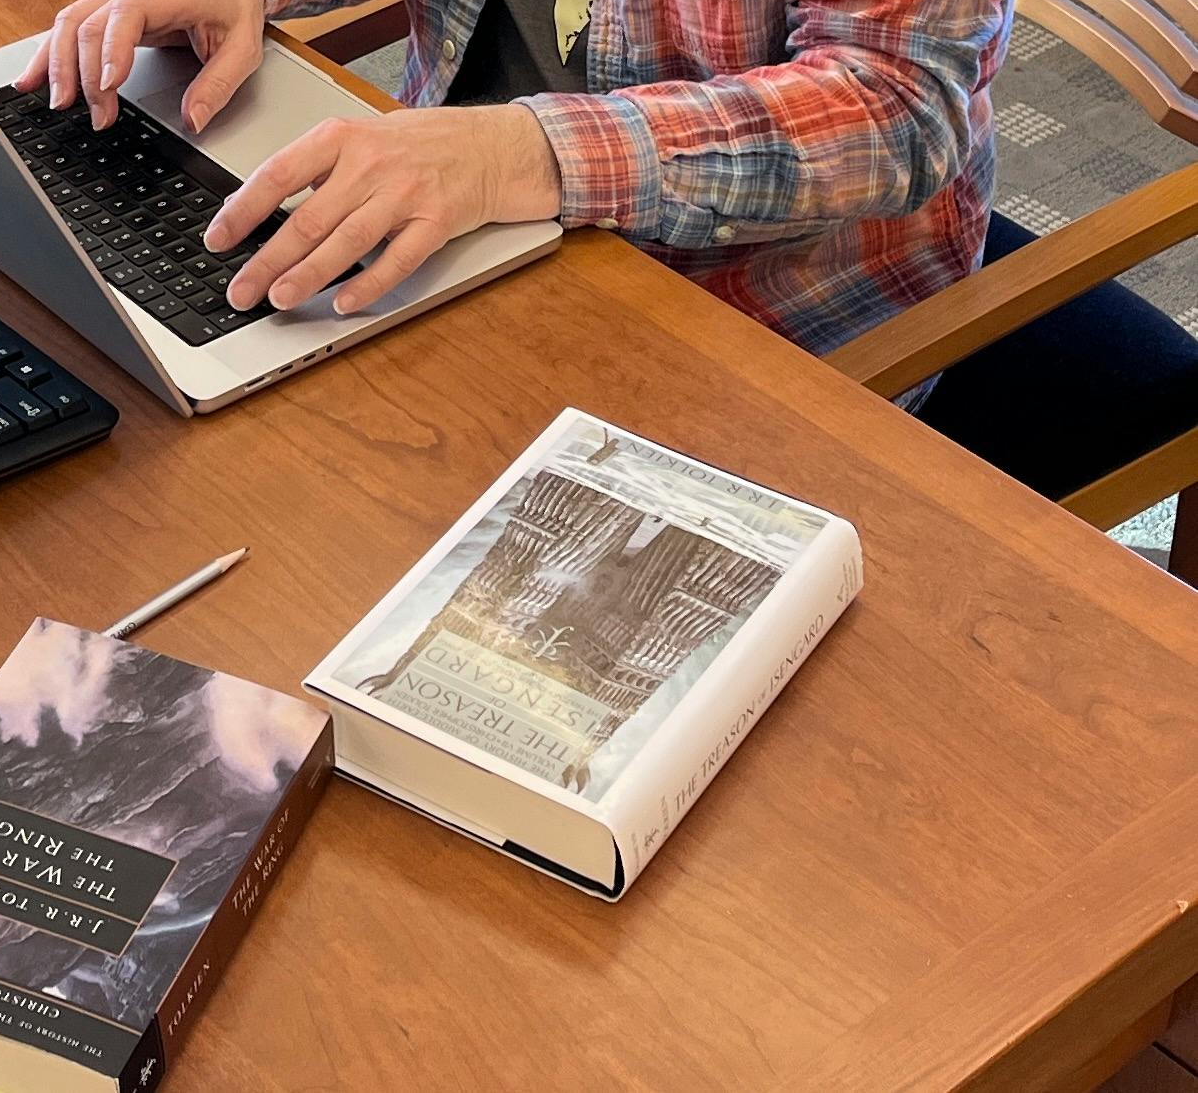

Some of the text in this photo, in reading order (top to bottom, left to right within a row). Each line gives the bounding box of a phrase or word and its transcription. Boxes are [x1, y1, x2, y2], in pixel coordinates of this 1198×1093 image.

[626, 442, 716, 484] TOLKIEN
[397, 672, 514, 737] TREASON
[424, 646, 596, 734] ISENGARD
[488, 697, 507, 708] OF
[673, 781, 699, 811] THE
[701, 705, 755, 780] TREASON
[769, 614, 825, 691] ISENGARD
[520, 728, 569, 763] THE
[2, 850, 63, 886] WAR
[70, 847, 114, 872] THE
[232, 808, 289, 910] THE WAR OF
[72, 875, 116, 903] THE
[243, 840, 284, 917] THE RING
[40, 903, 104, 934] J.R.R.
[168, 958, 210, 1036] TOLKIEN
[19, 1020, 33, 1030] OF
[36, 1026, 80, 1048] HISTORY
[83, 1043, 104, 1058] THE
